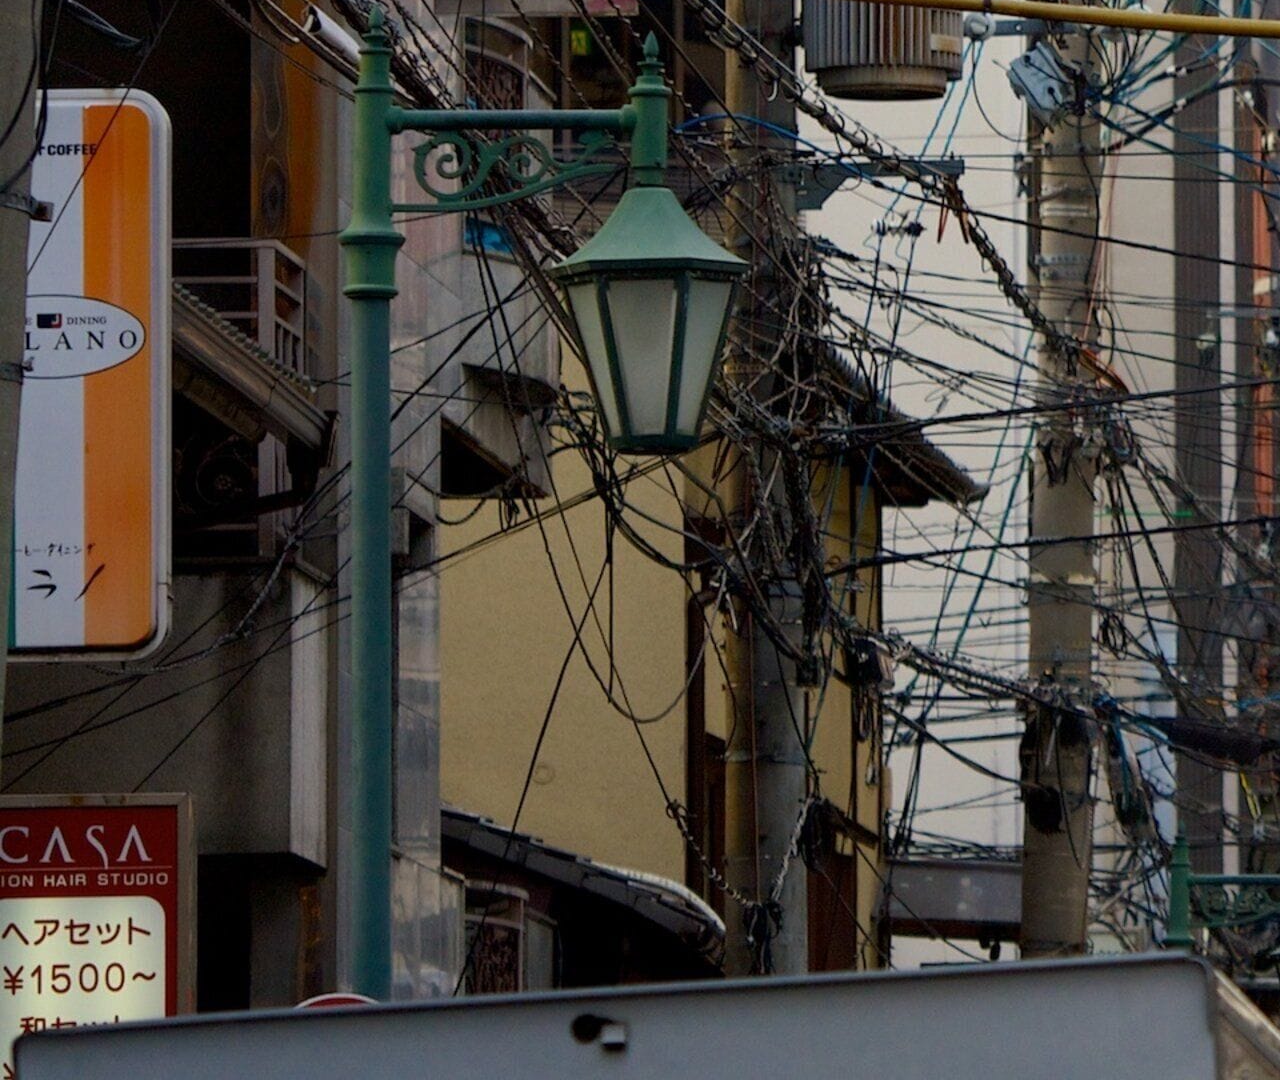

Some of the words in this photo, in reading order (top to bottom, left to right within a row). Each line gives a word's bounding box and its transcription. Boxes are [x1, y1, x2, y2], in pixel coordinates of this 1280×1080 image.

[66, 316, 107, 325] DINING
[0, 824, 153, 870] CASA
[43, 873, 88, 886] HAIR
[97, 872, 169, 886] STUDIO
[2, 917, 151, 946] ヘアセット
